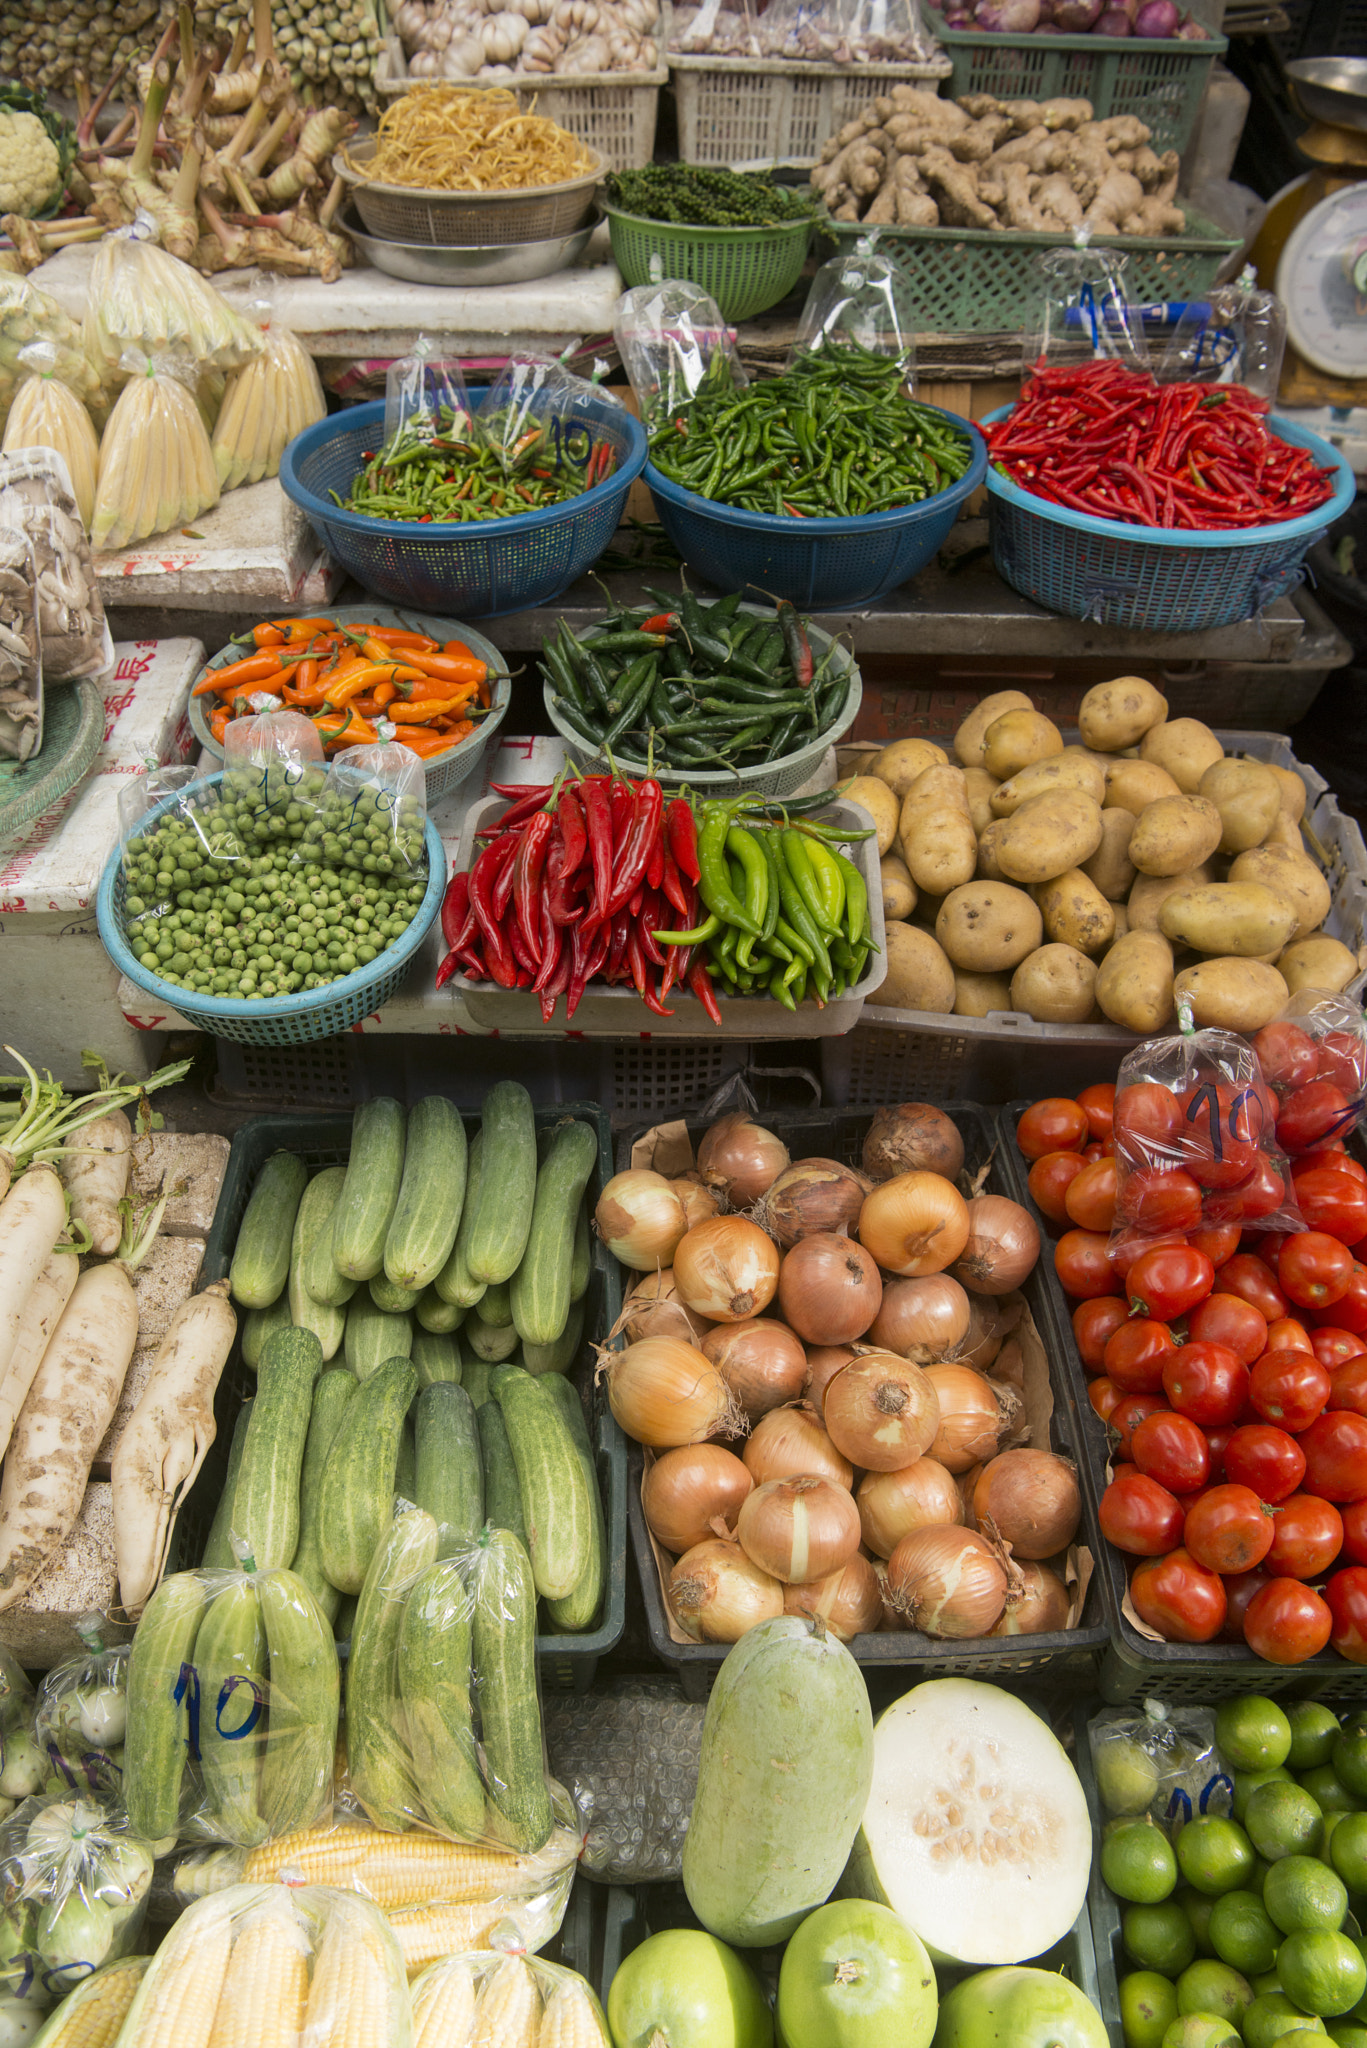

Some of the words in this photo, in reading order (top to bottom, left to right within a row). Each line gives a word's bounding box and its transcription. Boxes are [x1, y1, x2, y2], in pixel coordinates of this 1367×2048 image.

[551, 415, 592, 471] 10
[254, 765, 303, 817] 10
[339, 788, 397, 832] 10
[1186, 1082, 1264, 1164] 10
[174, 1661, 263, 1761] 10
[8, 1949, 96, 1999] 10
